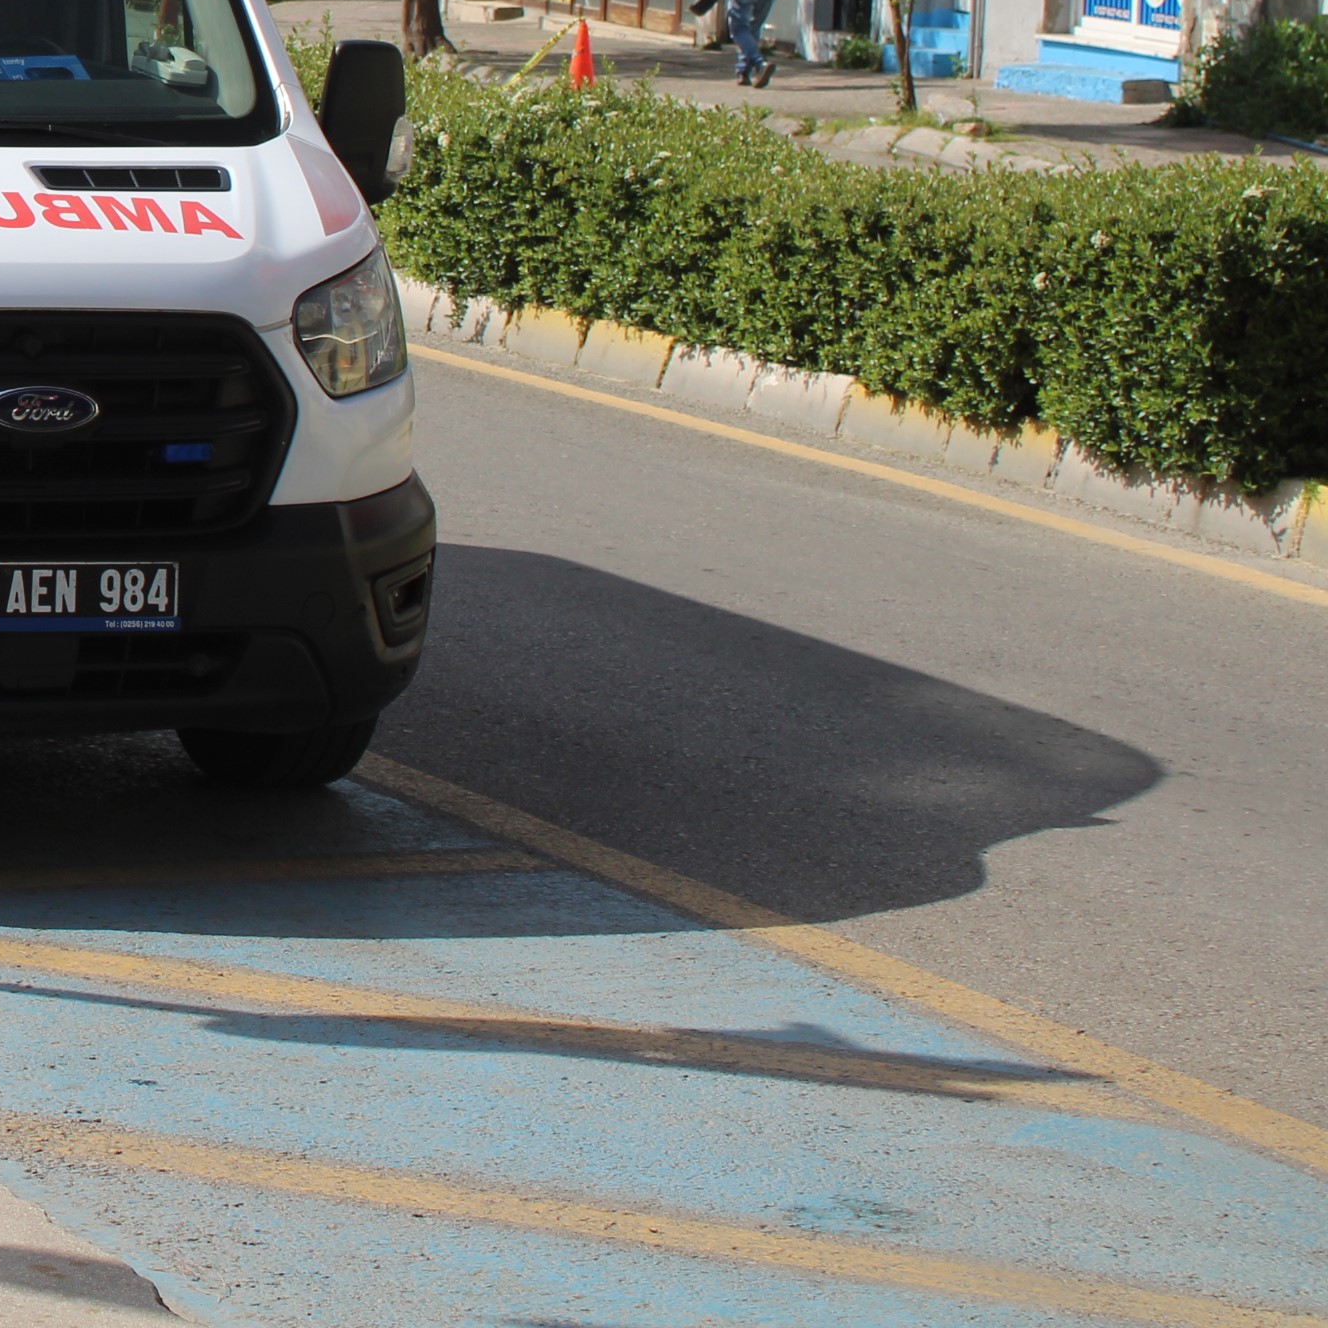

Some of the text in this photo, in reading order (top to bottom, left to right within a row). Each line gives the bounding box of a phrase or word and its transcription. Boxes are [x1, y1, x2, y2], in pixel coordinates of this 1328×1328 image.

[11, 393, 75, 421] Ford
[6, 569, 77, 613] AEN
[100, 568, 168, 613] 984
